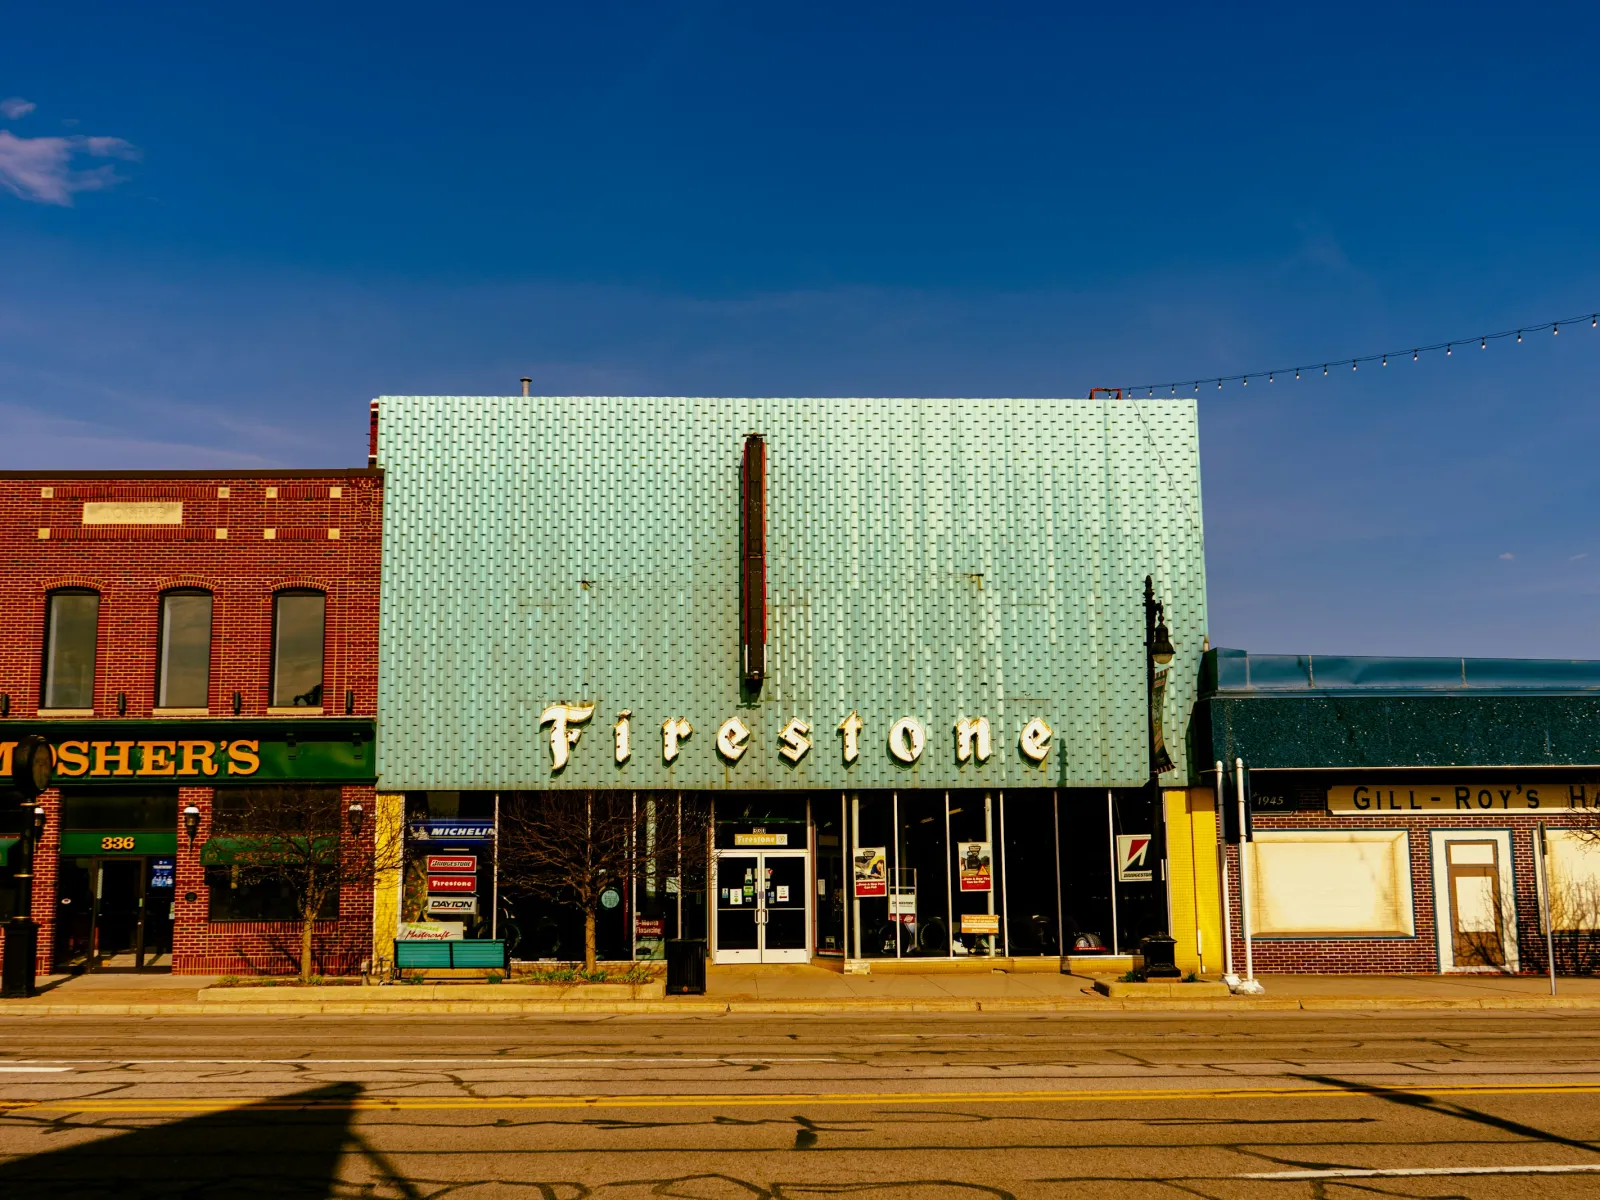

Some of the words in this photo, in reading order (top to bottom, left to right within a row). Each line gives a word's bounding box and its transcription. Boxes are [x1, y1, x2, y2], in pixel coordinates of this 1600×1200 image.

[540, 702, 1054, 771] Firestone
[1257, 796, 1284, 806] 1945
[431, 827, 495, 836] MICHELIN
[101, 836, 135, 850] 336
[737, 835, 775, 844] Firestone
[431, 900, 473, 908] DAYTON
[404, 930, 450, 940] Mastercraft
